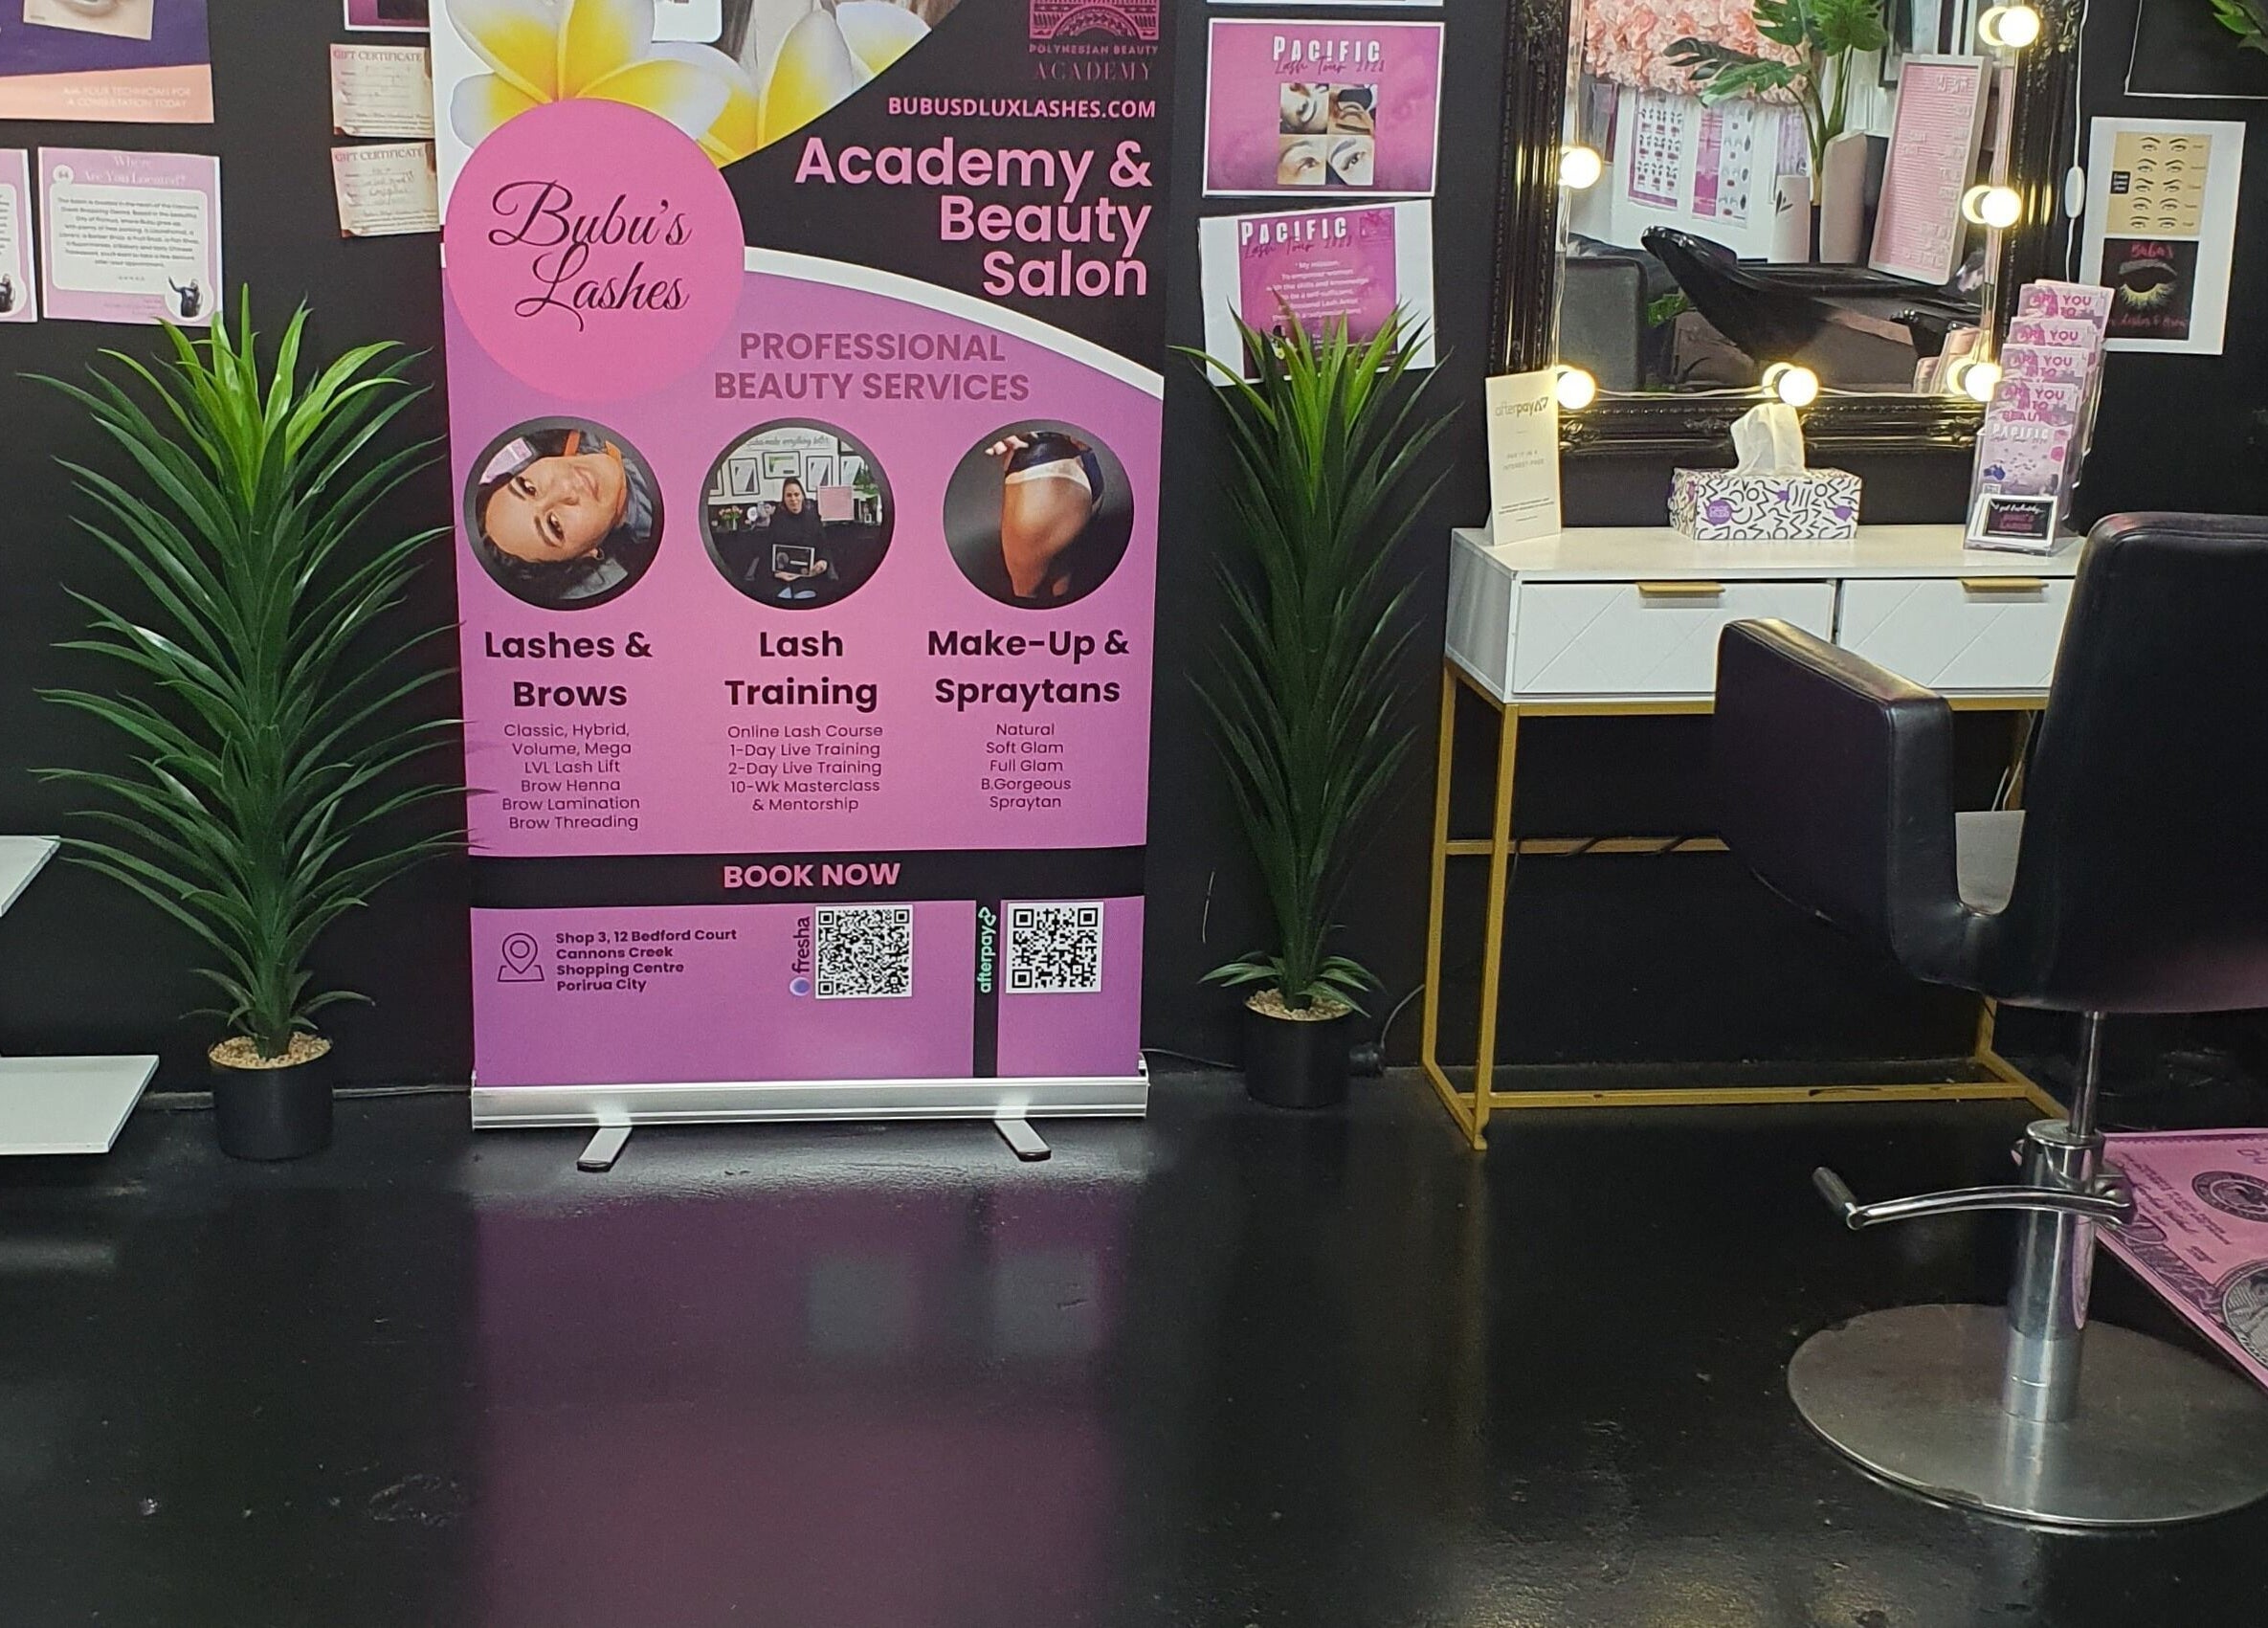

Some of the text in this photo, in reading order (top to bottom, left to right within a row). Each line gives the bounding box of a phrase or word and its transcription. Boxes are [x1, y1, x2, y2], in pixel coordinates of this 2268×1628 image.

[333, 50, 422, 61] GIFT CERTIFICATE
[1029, 44, 1158, 55] POLYNESIAN BEAUTY
[1273, 35, 1380, 62] PACIFIC
[1034, 61, 1153, 81] ACADEMY
[888, 97, 1156, 118] BUBUSDLUXLASHES.COM
[335, 148, 423, 162] GIFT CERTIFICATE
[106, 171, 128, 183] You
[794, 136, 1153, 203] Academy &
[488, 179, 692, 246] Bubu's
[940, 194, 1152, 258] Beauty
[1240, 217, 1347, 245] PACIFIC
[983, 249, 1147, 297] Salon
[514, 241, 690, 332] Lashes
[2062, 295, 2093, 305] YOU
[2050, 330, 2079, 341] YOU
[739, 332, 1006, 362] PROFESSIONAL
[2044, 355, 2073, 367] YOU
[714, 371, 1030, 402] BEAUTY SERVICES
[2035, 389, 2064, 400] YOU
[1495, 400, 1535, 418] afterpay
[485, 631, 653, 658] Lashes &
[760, 630, 844, 657] Lash
[928, 629, 1130, 665] Make-Up &
[513, 681, 627, 706] Brows
[724, 676, 878, 713] Training
[935, 678, 1121, 712] Spraytans
[503, 723, 630, 739] Classic, Hybrid,
[727, 725, 883, 738] Online Lash Course
[996, 723, 1055, 736] Natural
[512, 742, 632, 758] Volume, Mega
[730, 743, 880, 759] 1-Day Live Training
[986, 741, 1064, 754] Soft Glam
[524, 759, 620, 774] LVL Lash Lift
[728, 760, 882, 777] 2-Day Live Training
[989, 759, 1063, 772] Full Glam
[521, 779, 620, 792] Brow Henna
[730, 780, 880, 793] 10-Wk Masterclass
[981, 777, 1072, 793] B.Gorgeous
[502, 795, 640, 811] Brow Lamination
[752, 797, 859, 814] & Mentorship
[989, 795, 1061, 812] Spraytan
[509, 815, 638, 831] Brow Threading
[723, 863, 901, 888] BOOK NOW
[556, 928, 737, 946] Shop 3, 12 Bedford Court
[791, 916, 811, 974] fresha
[556, 946, 673, 960] Cannons Creek
[976, 924, 996, 993] afterpay
[557, 962, 684, 977] Shopping Centre
[557, 978, 647, 992] Porirua City
